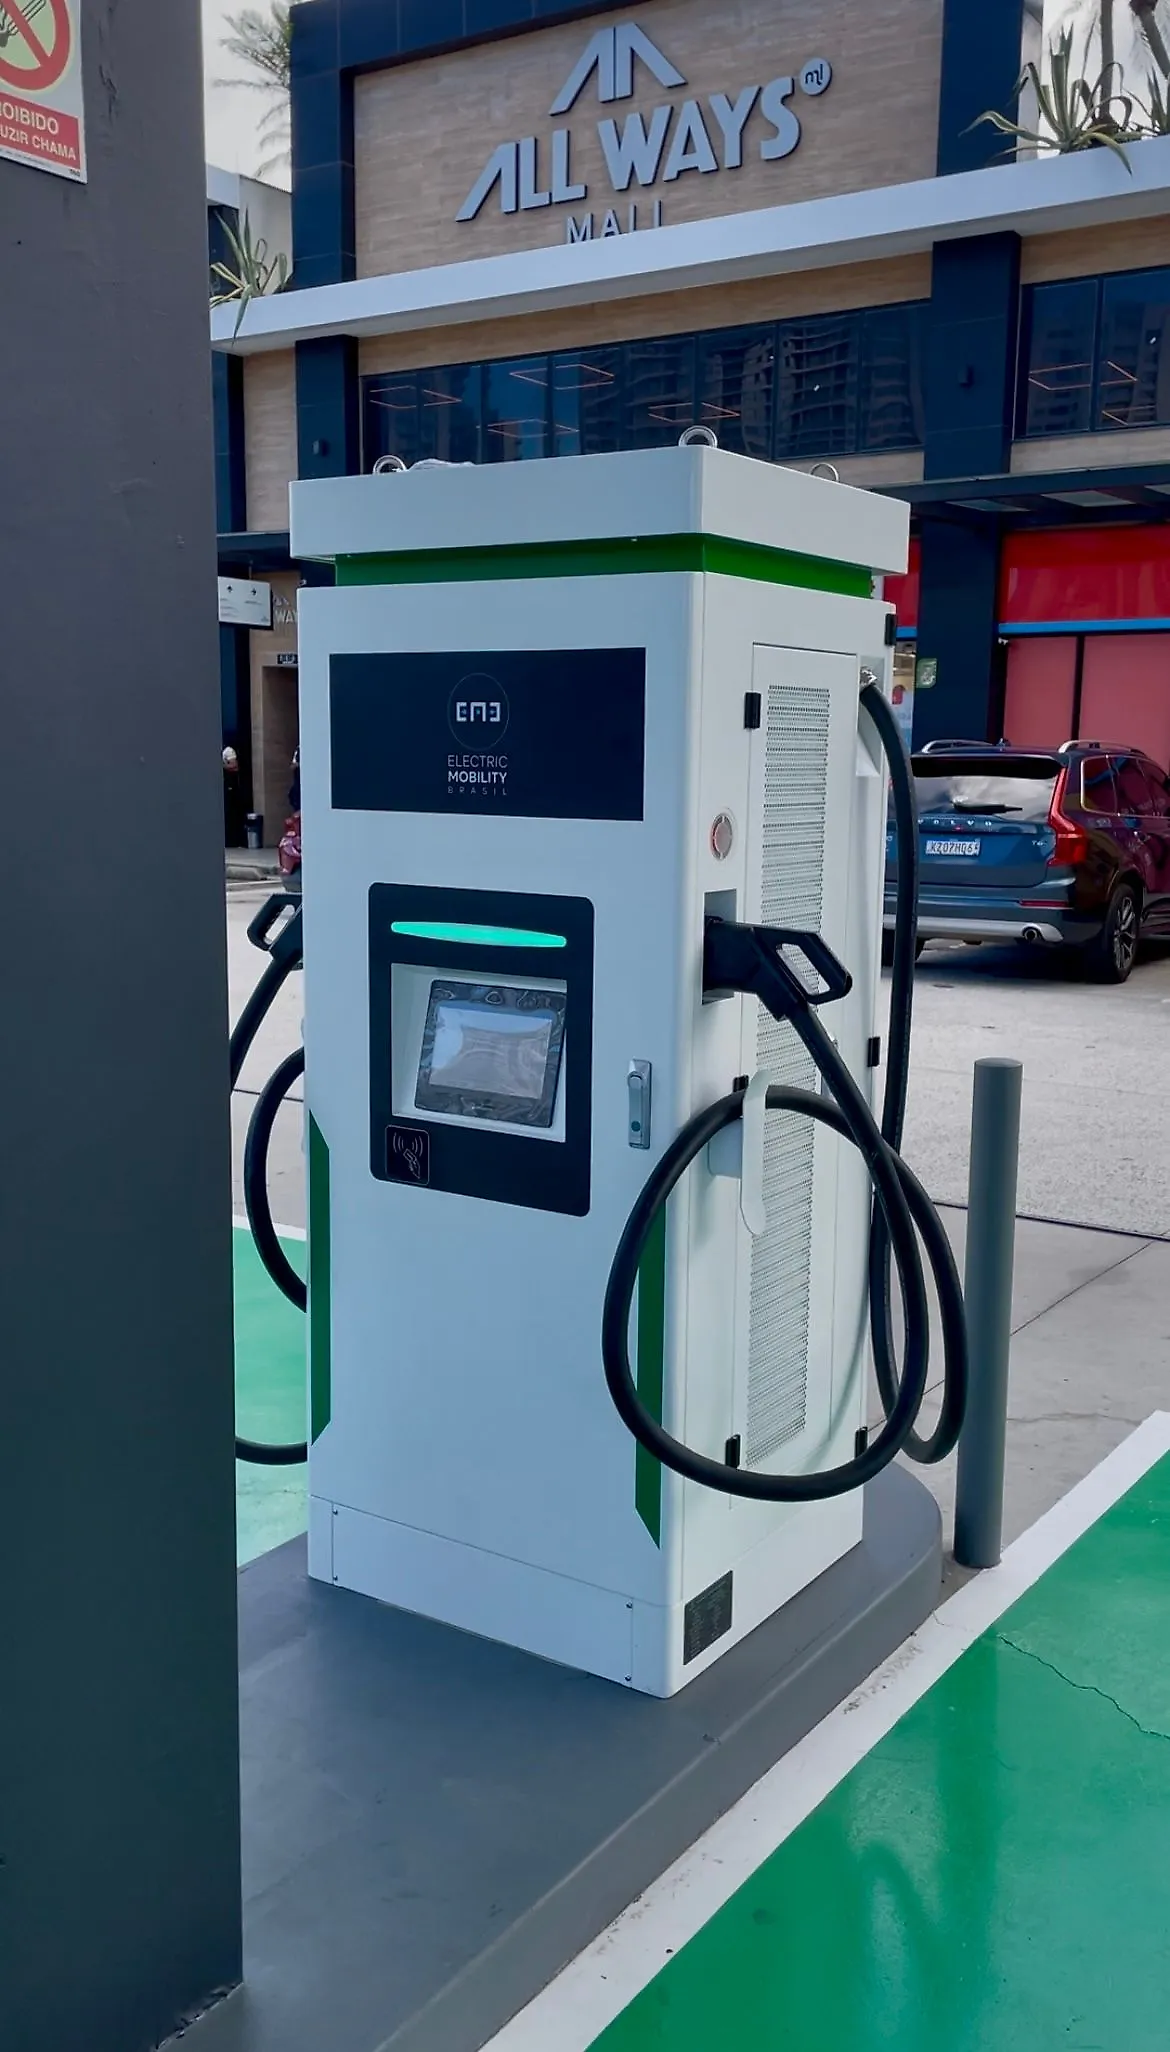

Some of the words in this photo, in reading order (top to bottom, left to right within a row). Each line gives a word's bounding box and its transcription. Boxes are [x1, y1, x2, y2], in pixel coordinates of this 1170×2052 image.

[0, 101, 59, 135] OIBIDO
[31, 134, 77, 161] CHAMA
[455, 128, 588, 222] ALL
[597, 75, 801, 191] WAYS
[447, 754, 508, 769] ELECTRIC
[447, 770, 508, 784] MOBILITY
[447, 785, 508, 796] BRASIL
[917, 818, 992, 827] VOLVO
